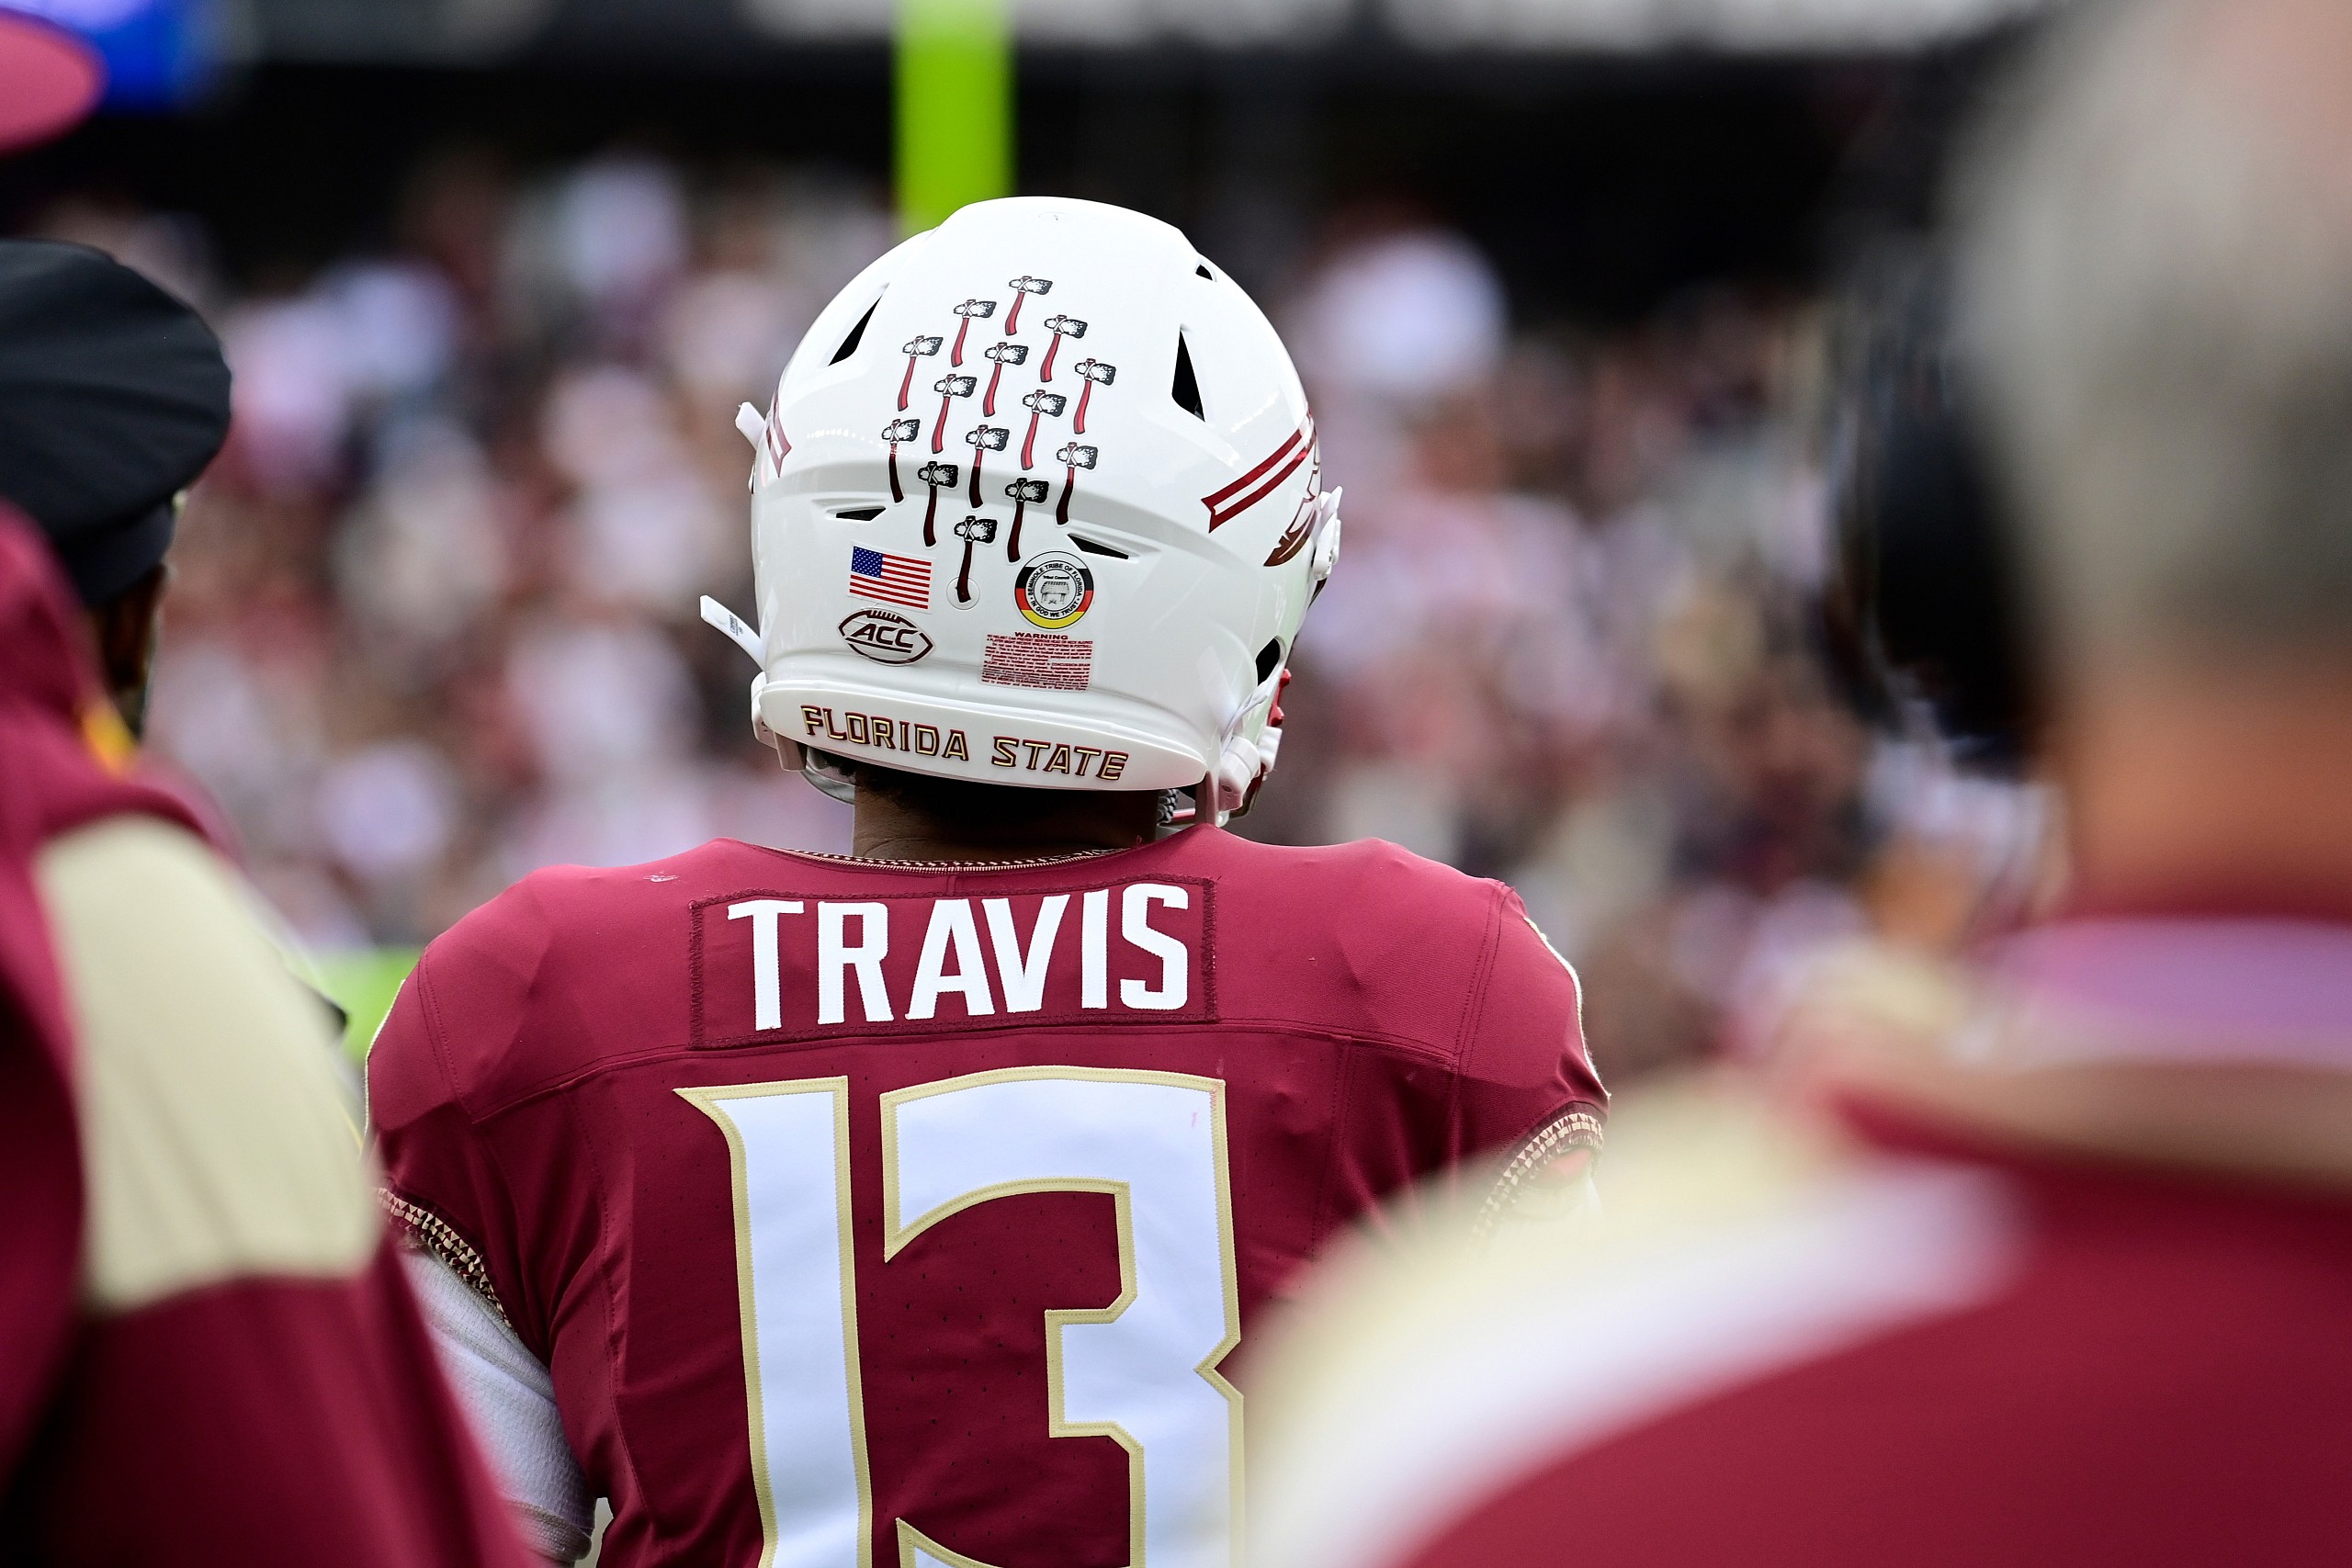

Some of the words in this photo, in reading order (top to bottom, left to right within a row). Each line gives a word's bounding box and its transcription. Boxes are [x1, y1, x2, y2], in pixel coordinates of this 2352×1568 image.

[1072, 570, 1082, 597] FLORIDA
[1035, 606, 1049, 617] GOD
[1061, 601, 1080, 615] TRUST
[851, 623, 919, 649] ACC
[1015, 632, 1069, 640] WARNING
[800, 705, 969, 761] FLORIDA
[990, 735, 1130, 782] STATE
[728, 884, 1189, 1032] TRAVIS
[674, 1065, 1247, 1568] 13
